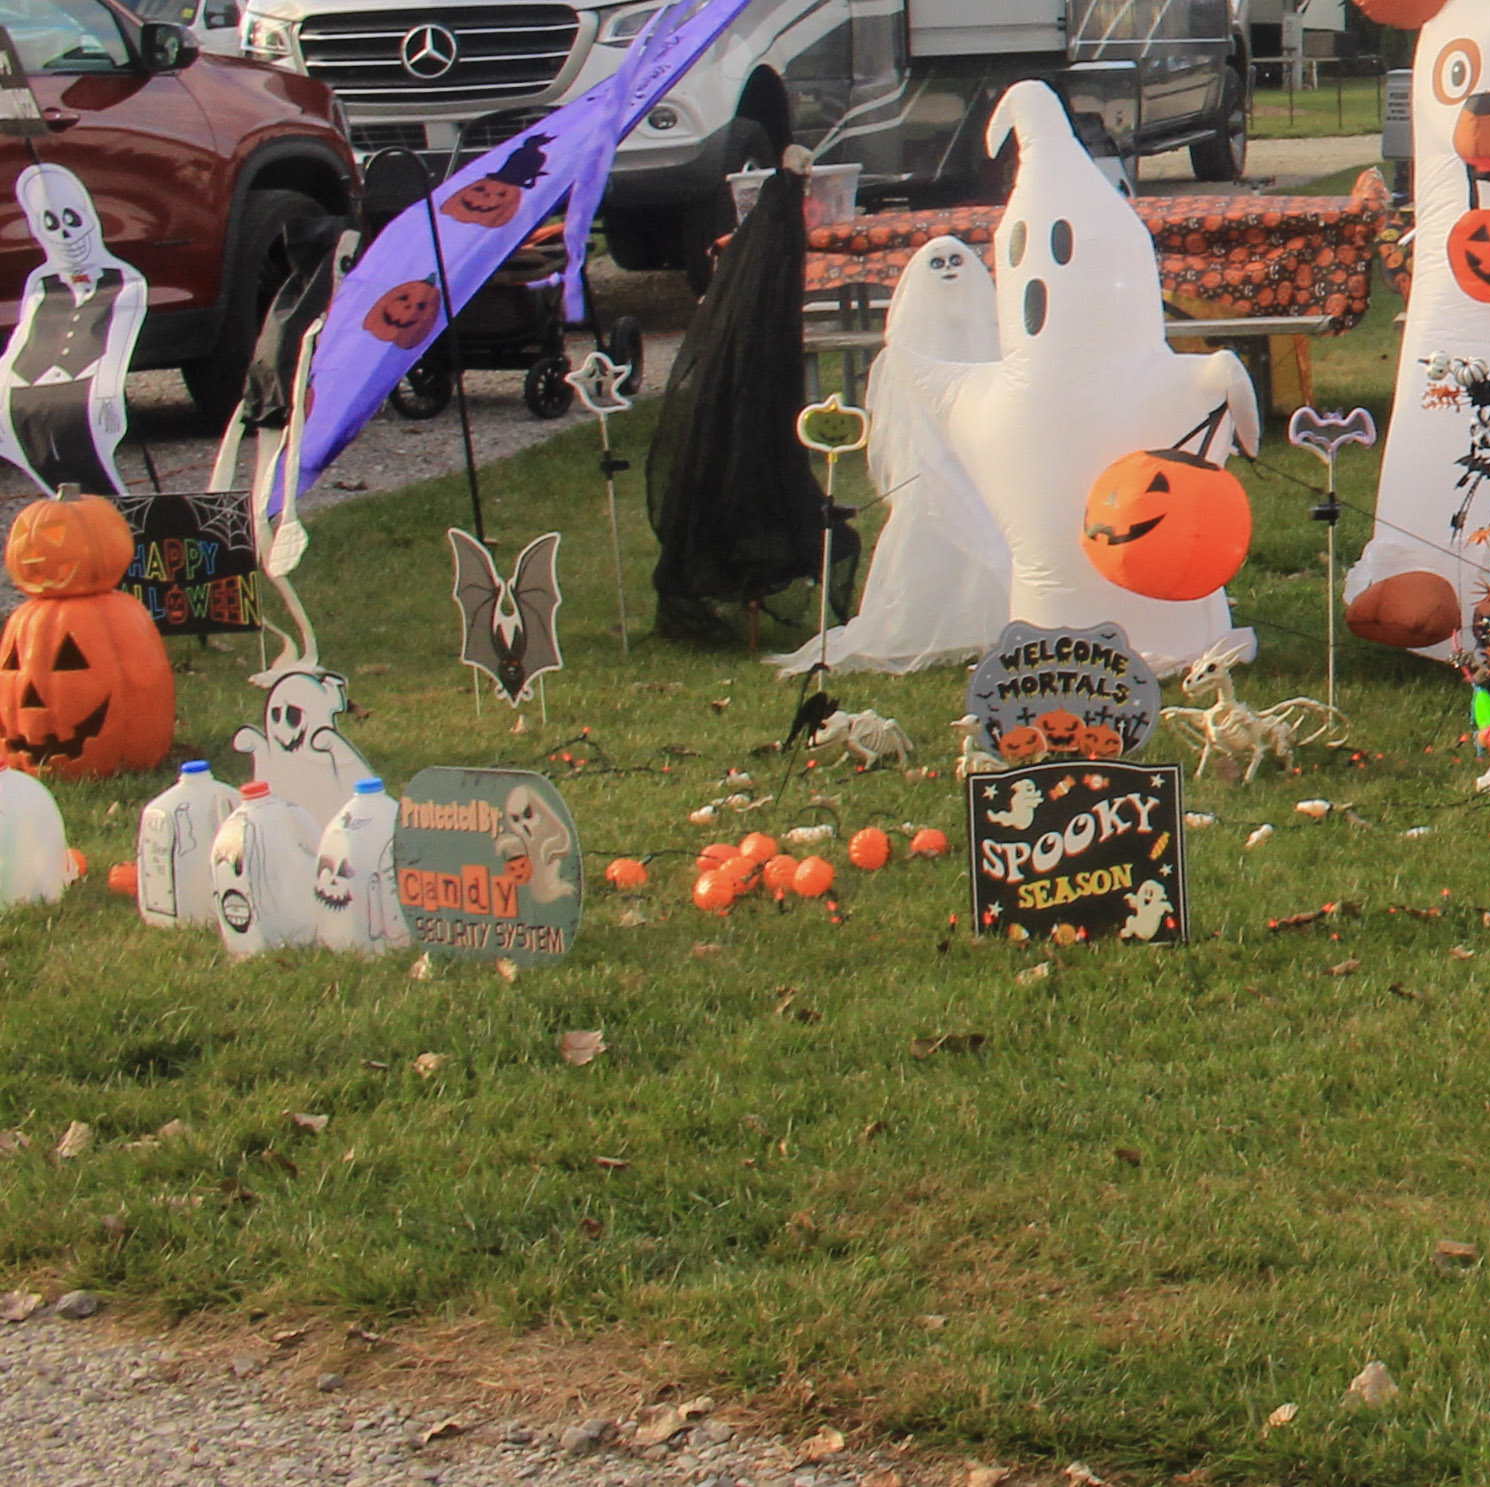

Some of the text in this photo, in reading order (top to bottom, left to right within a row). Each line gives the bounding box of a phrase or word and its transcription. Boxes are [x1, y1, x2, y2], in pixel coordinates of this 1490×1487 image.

[128, 539, 219, 582] HAPPY
[999, 636, 1129, 678] WELCOME
[996, 671, 1130, 706] MORTALS
[982, 792, 1160, 884] SPOOKY
[1018, 863, 1134, 910] SEASON
[416, 916, 565, 953] SECURITY SYSTEM
